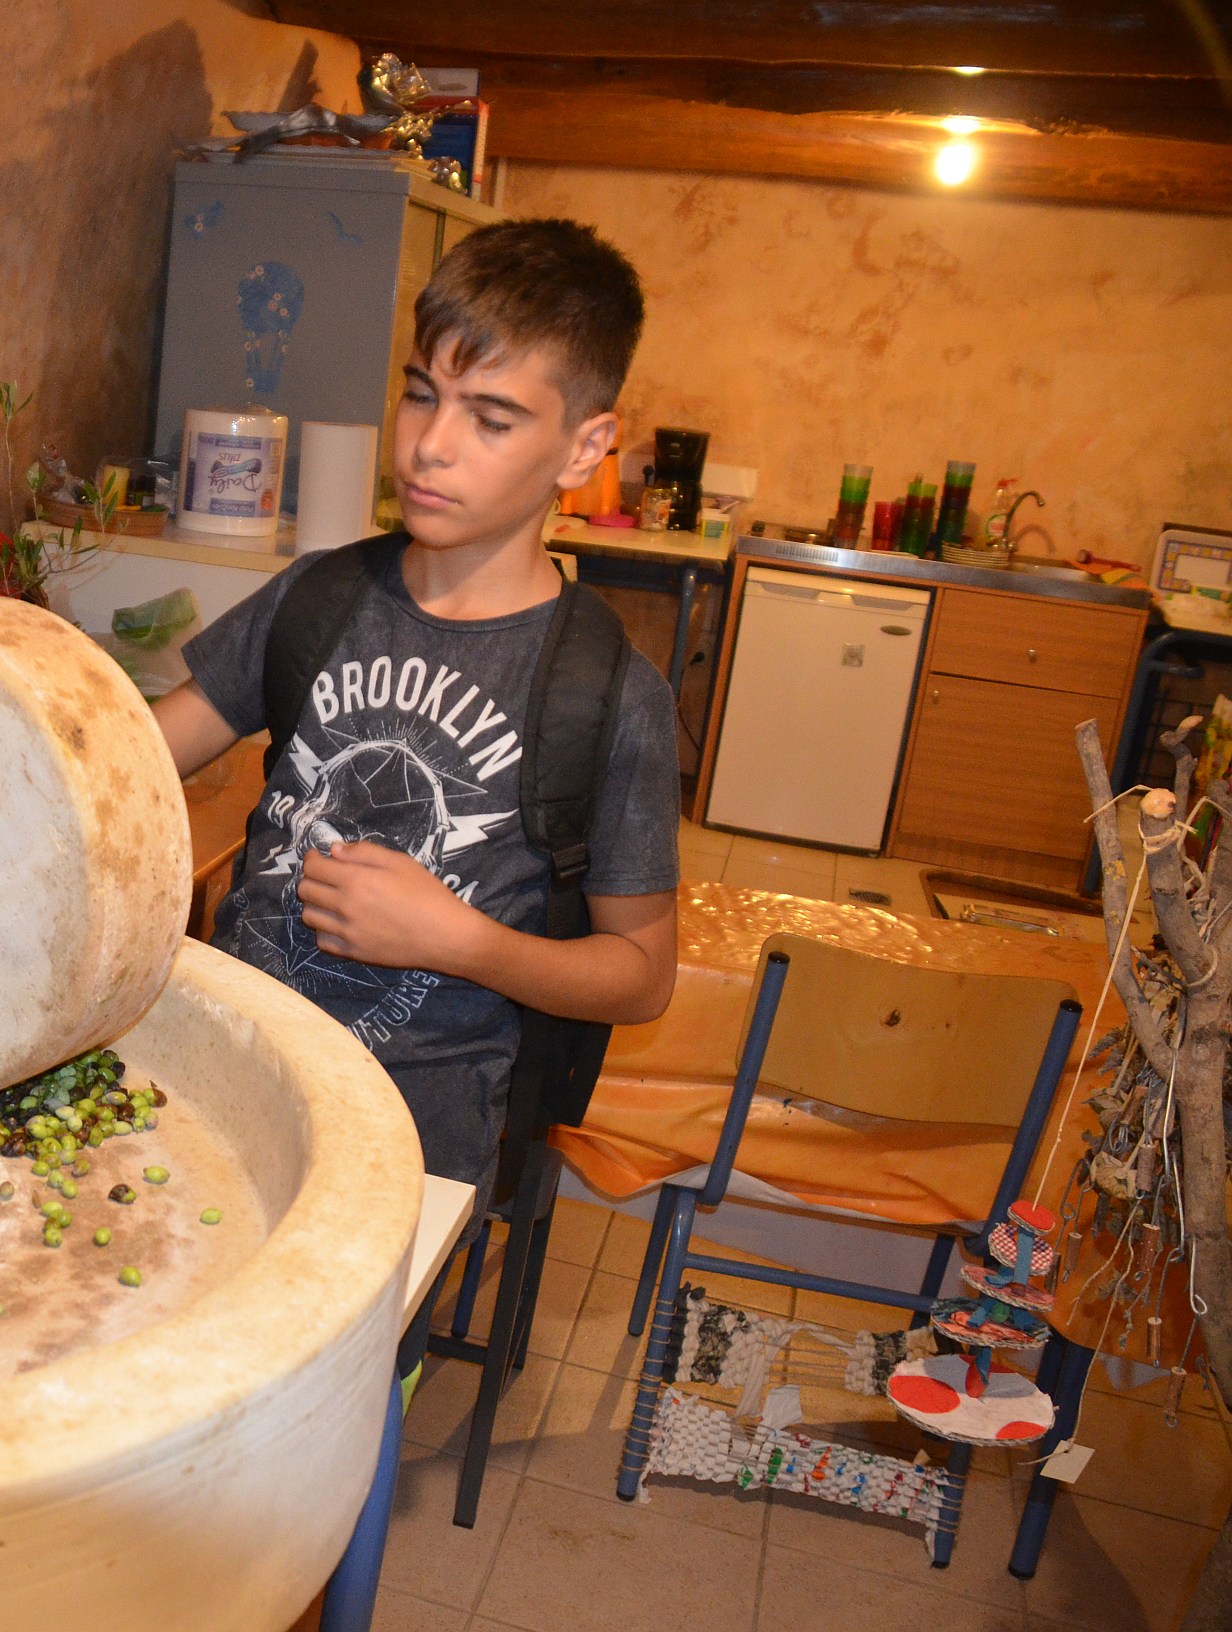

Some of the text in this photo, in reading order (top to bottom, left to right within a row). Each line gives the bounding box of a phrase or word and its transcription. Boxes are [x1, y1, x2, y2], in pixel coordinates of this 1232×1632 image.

[218, 452, 241, 462] plus
[208, 473, 262, 493] Daily
[312, 655, 523, 782] BROOKLYN
